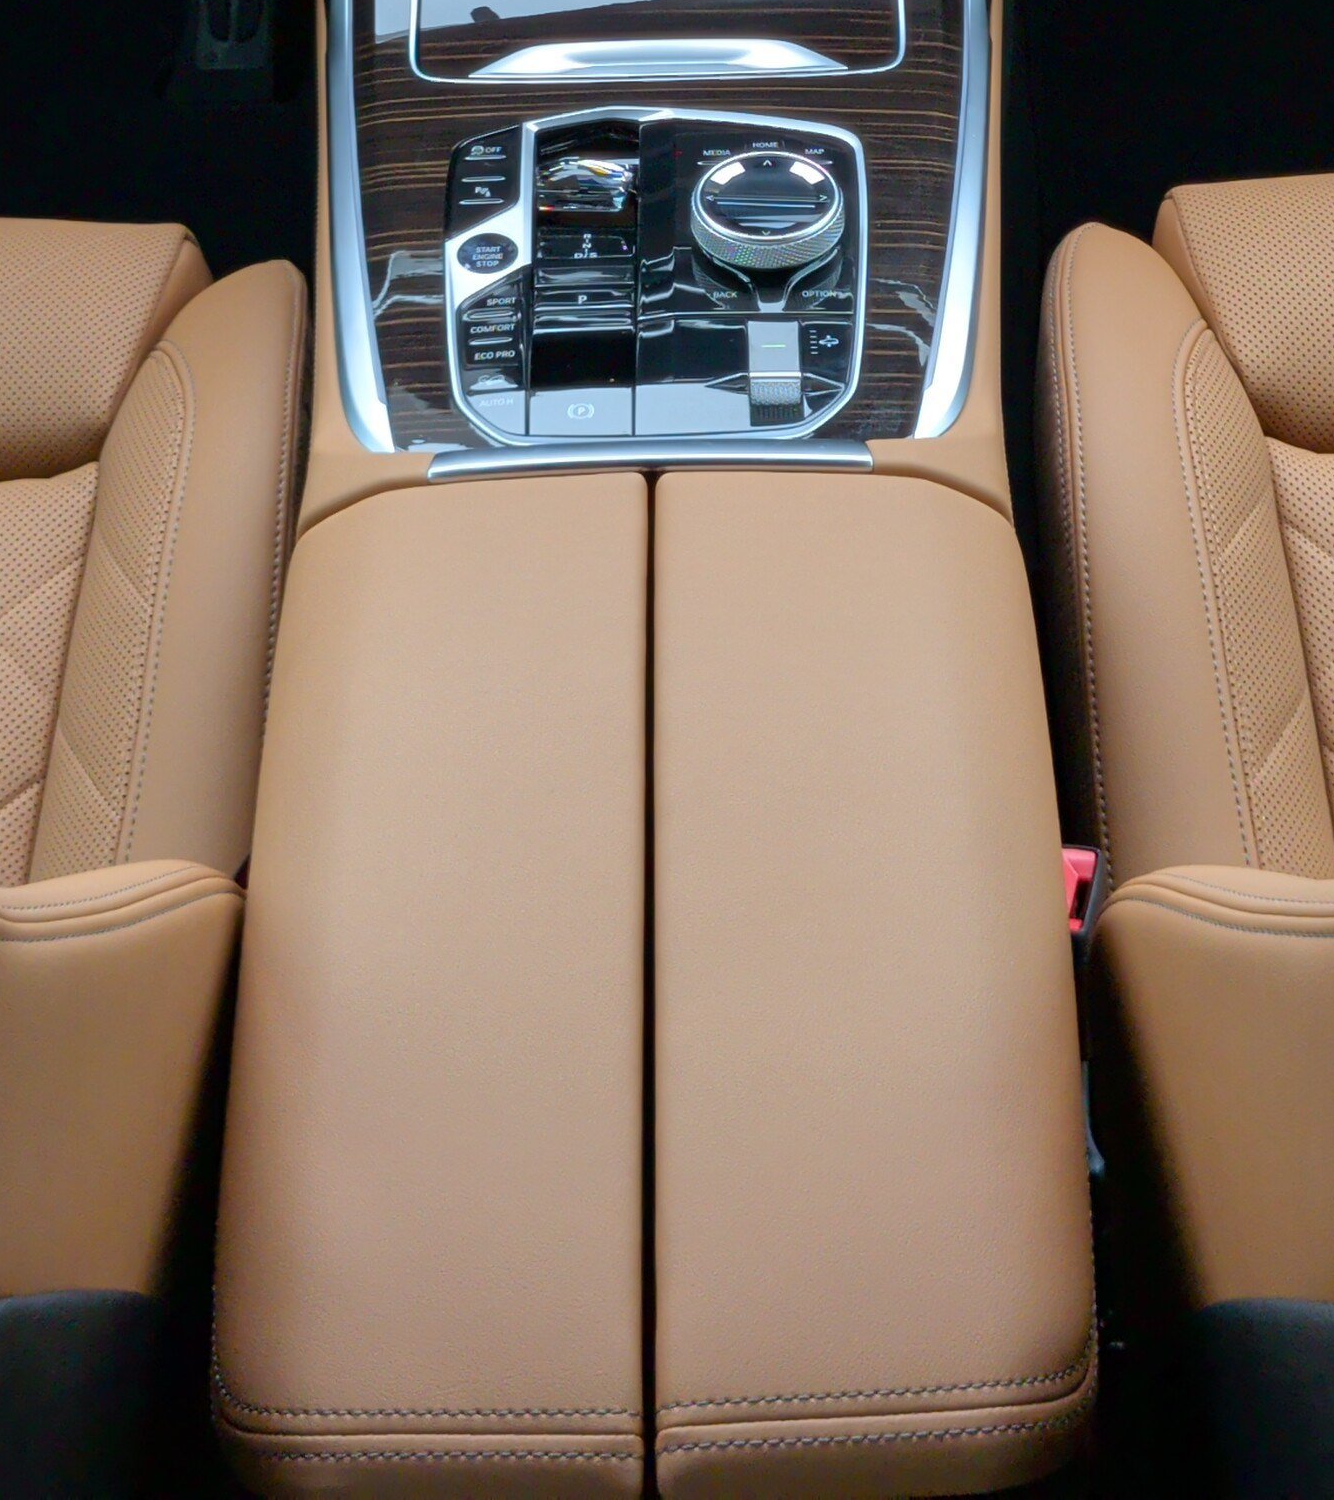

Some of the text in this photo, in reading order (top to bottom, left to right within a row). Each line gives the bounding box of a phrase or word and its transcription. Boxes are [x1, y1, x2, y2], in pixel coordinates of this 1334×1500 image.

[752, 141, 779, 149] HOME
[484, 146, 502, 154] OFF
[702, 149, 731, 157] MEDIA
[475, 246, 502, 254] START
[472, 253, 504, 261] ENGINE
[476, 260, 500, 268] STOP
[712, 291, 738, 299] BACK
[801, 290, 838, 298] OPTION
[486, 297, 517, 307] SPORT
[578, 295, 587, 304] P
[470, 323, 516, 334] COMFORT
[474, 350, 516, 361] ECO PRO
[479, 398, 505, 407] AUTO
